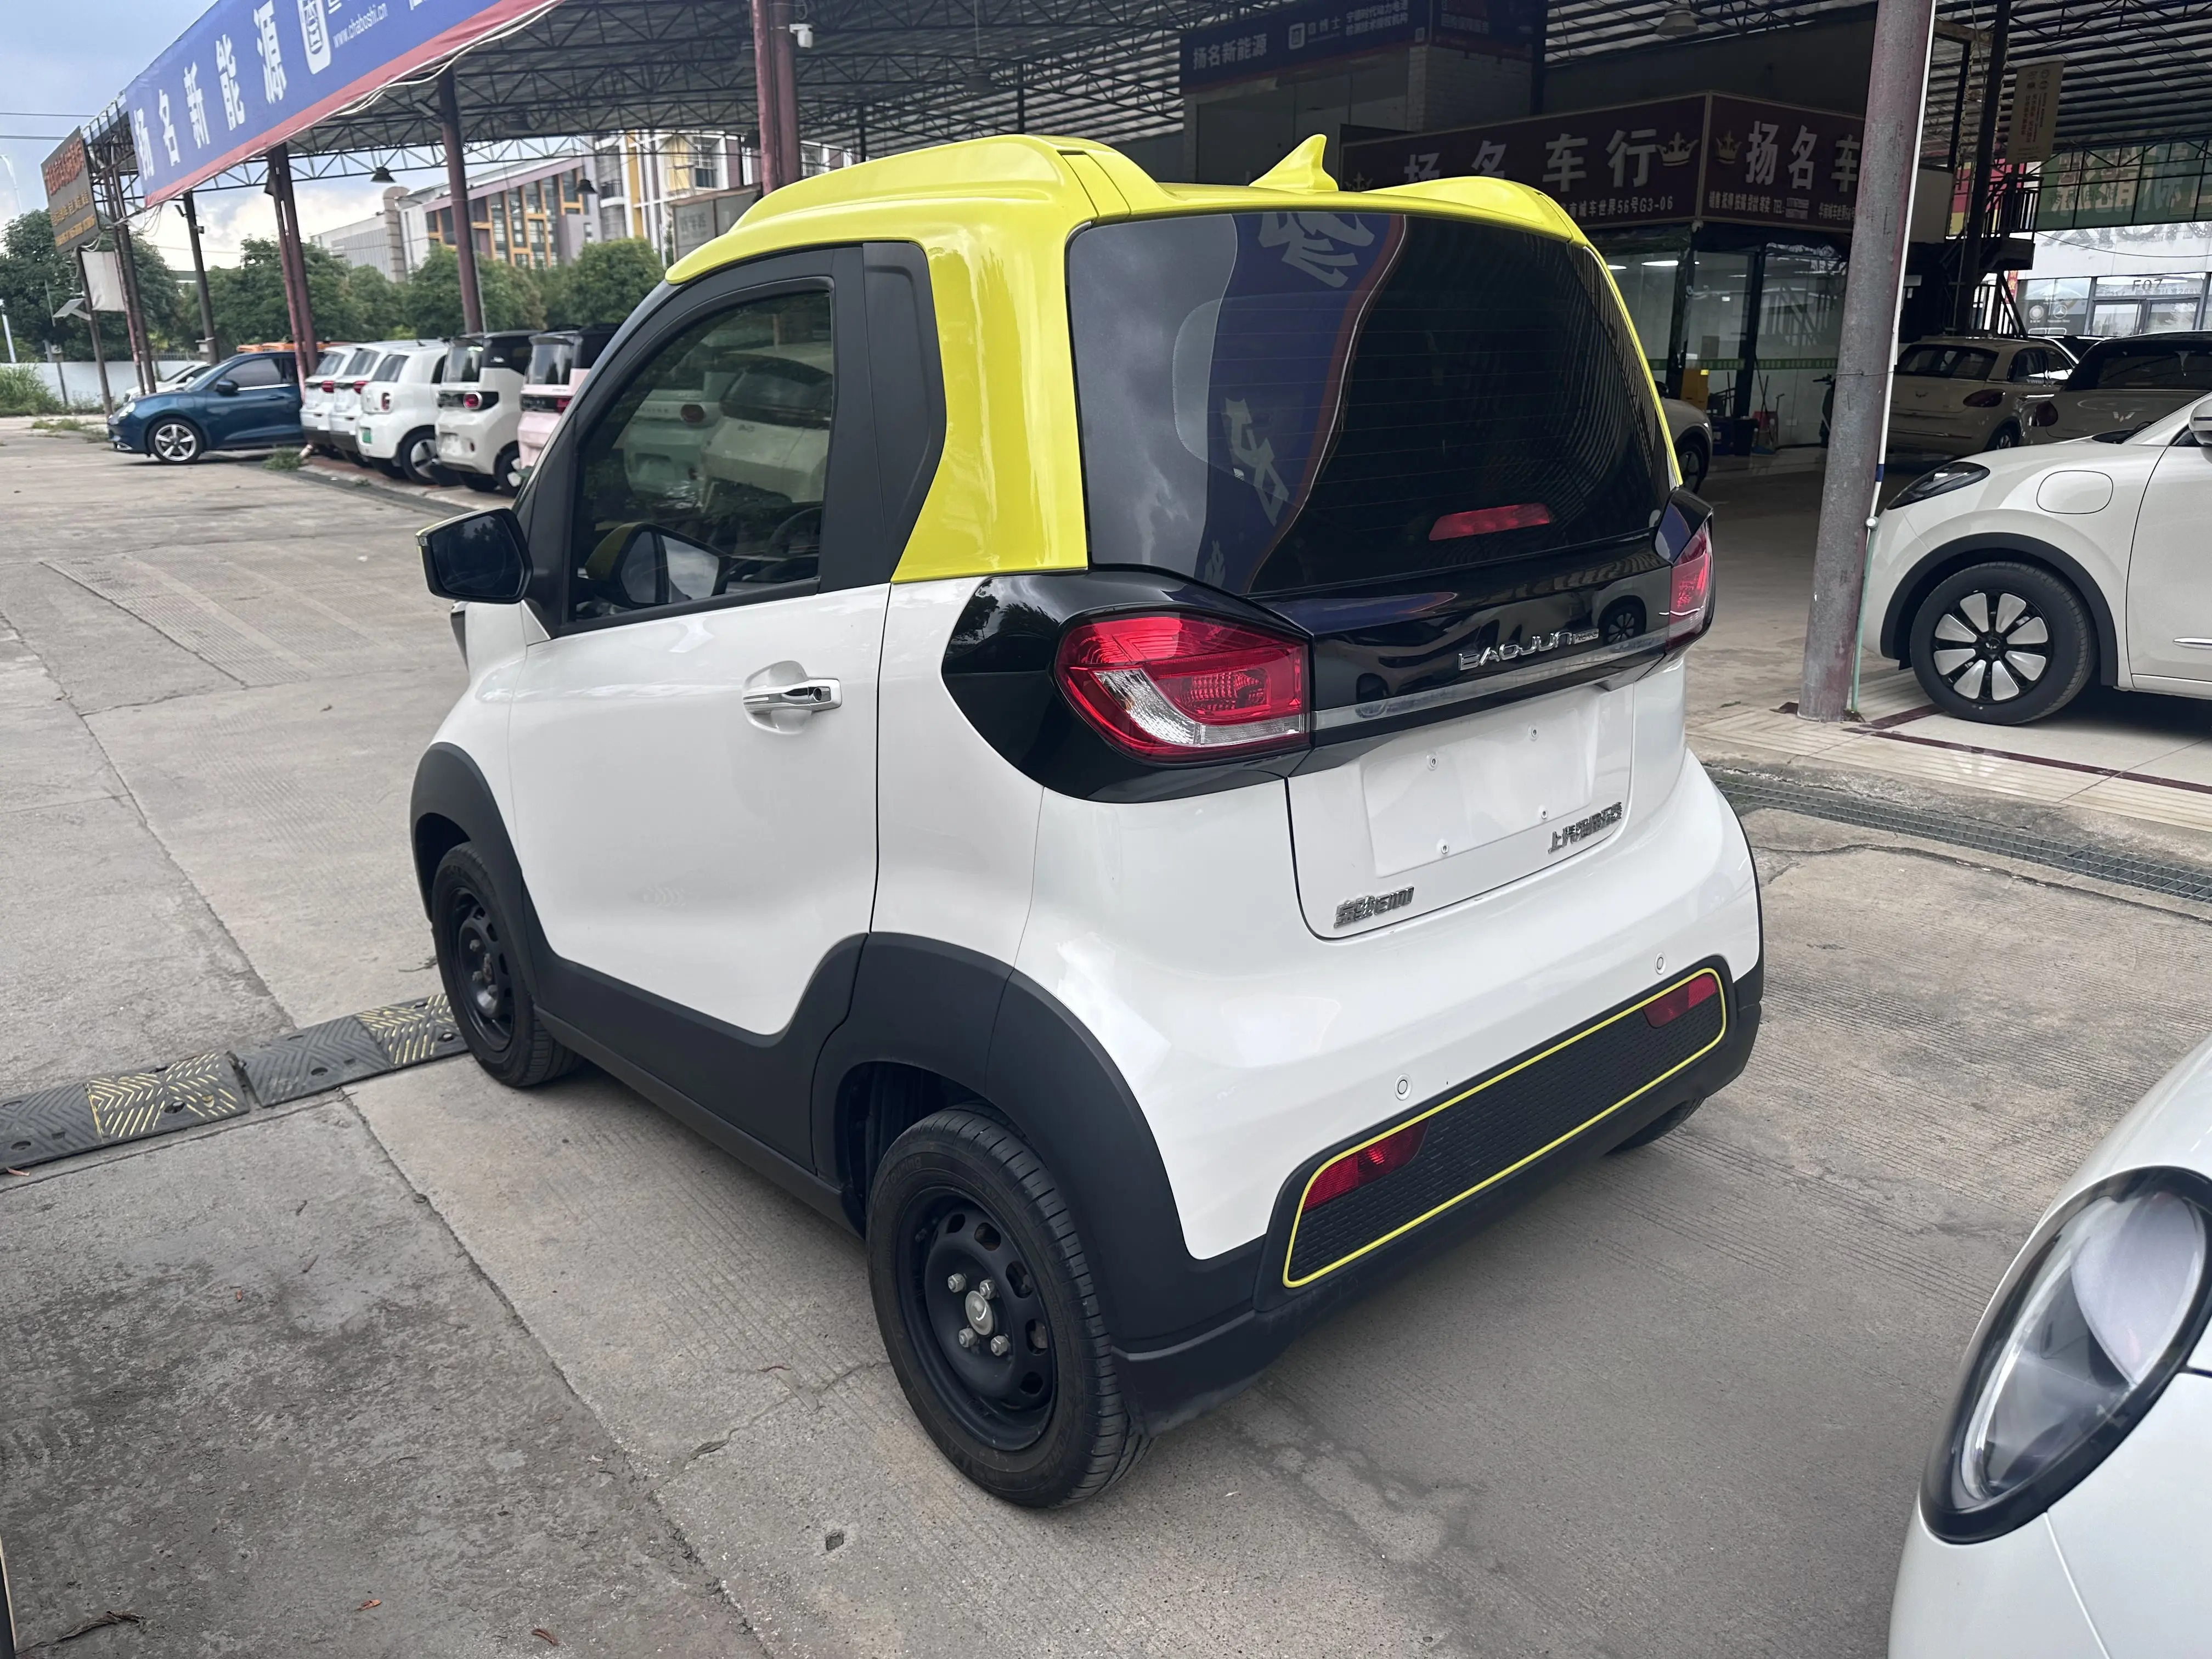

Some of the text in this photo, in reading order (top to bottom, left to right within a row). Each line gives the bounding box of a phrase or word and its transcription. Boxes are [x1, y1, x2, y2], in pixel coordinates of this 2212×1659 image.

[1193, 33, 1267, 70] 扬名新能源
[1458, 631, 1573, 671] BAOJUN
